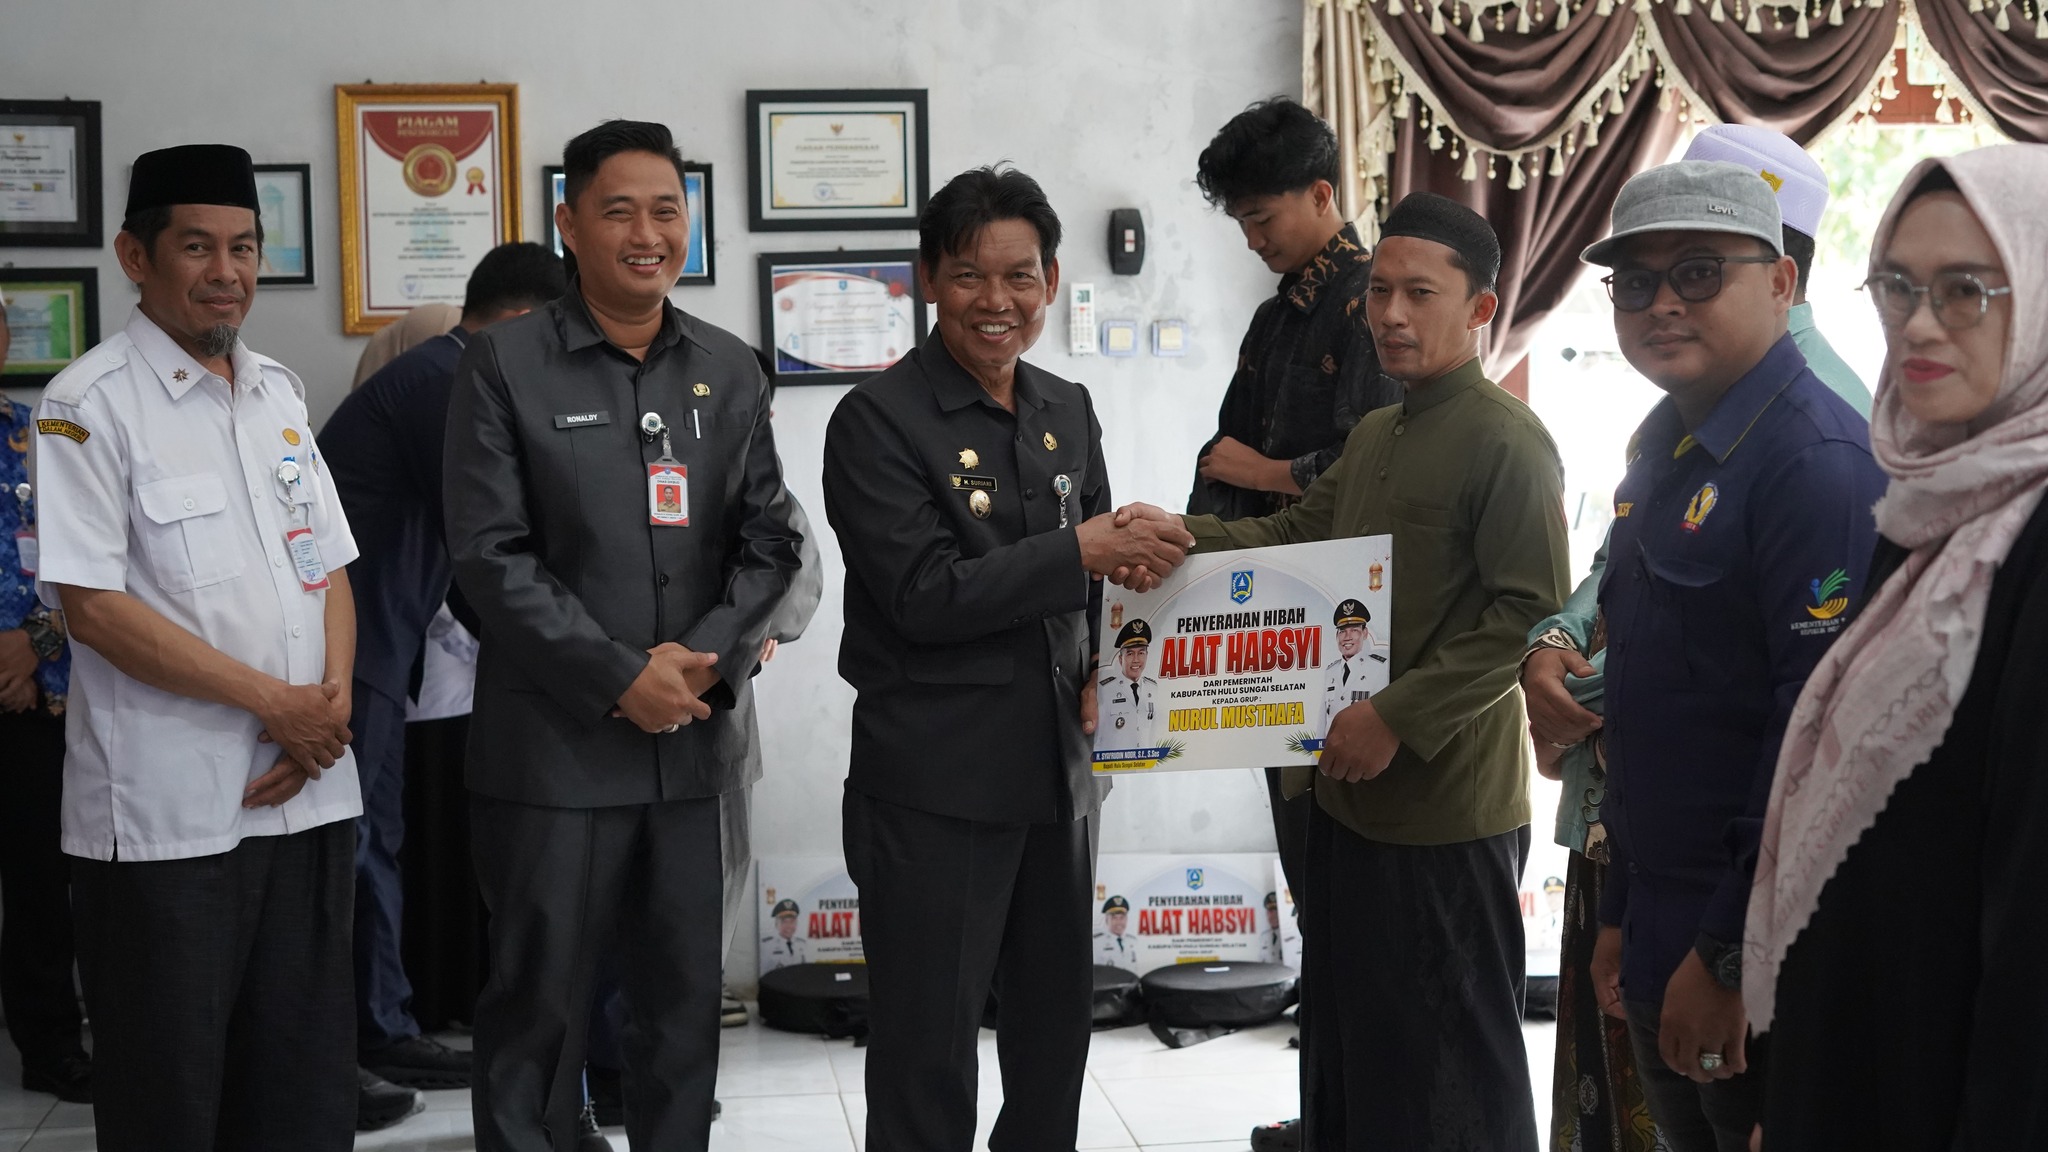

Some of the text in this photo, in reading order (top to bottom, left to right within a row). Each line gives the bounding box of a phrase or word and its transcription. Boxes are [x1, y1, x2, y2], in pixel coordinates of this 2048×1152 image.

[398, 116, 458, 127] PIAGAM
[566, 414, 598, 424] RONALDY
[41, 421, 86, 437] KEMENTERIAN
[64, 429, 82, 440] NEGERI
[1178, 607, 1305, 633] PENYERAHAN HIBAH
[1159, 626, 1322, 678] ALAT HABSYI
[1203, 676, 1273, 688] DARI PEMERINTAH
[1171, 683, 1306, 699] KABUPATEN HULU SUNGAI SELATAN
[1212, 697, 1239, 705] KEPADA
[1169, 702, 1305, 732] NURUL MUSTHAFA
[1149, 894, 1243, 906] PENYERAHAN HIBAH
[807, 912, 853, 939] ALAT
[1138, 907, 1257, 935] ALAT HABSYI
